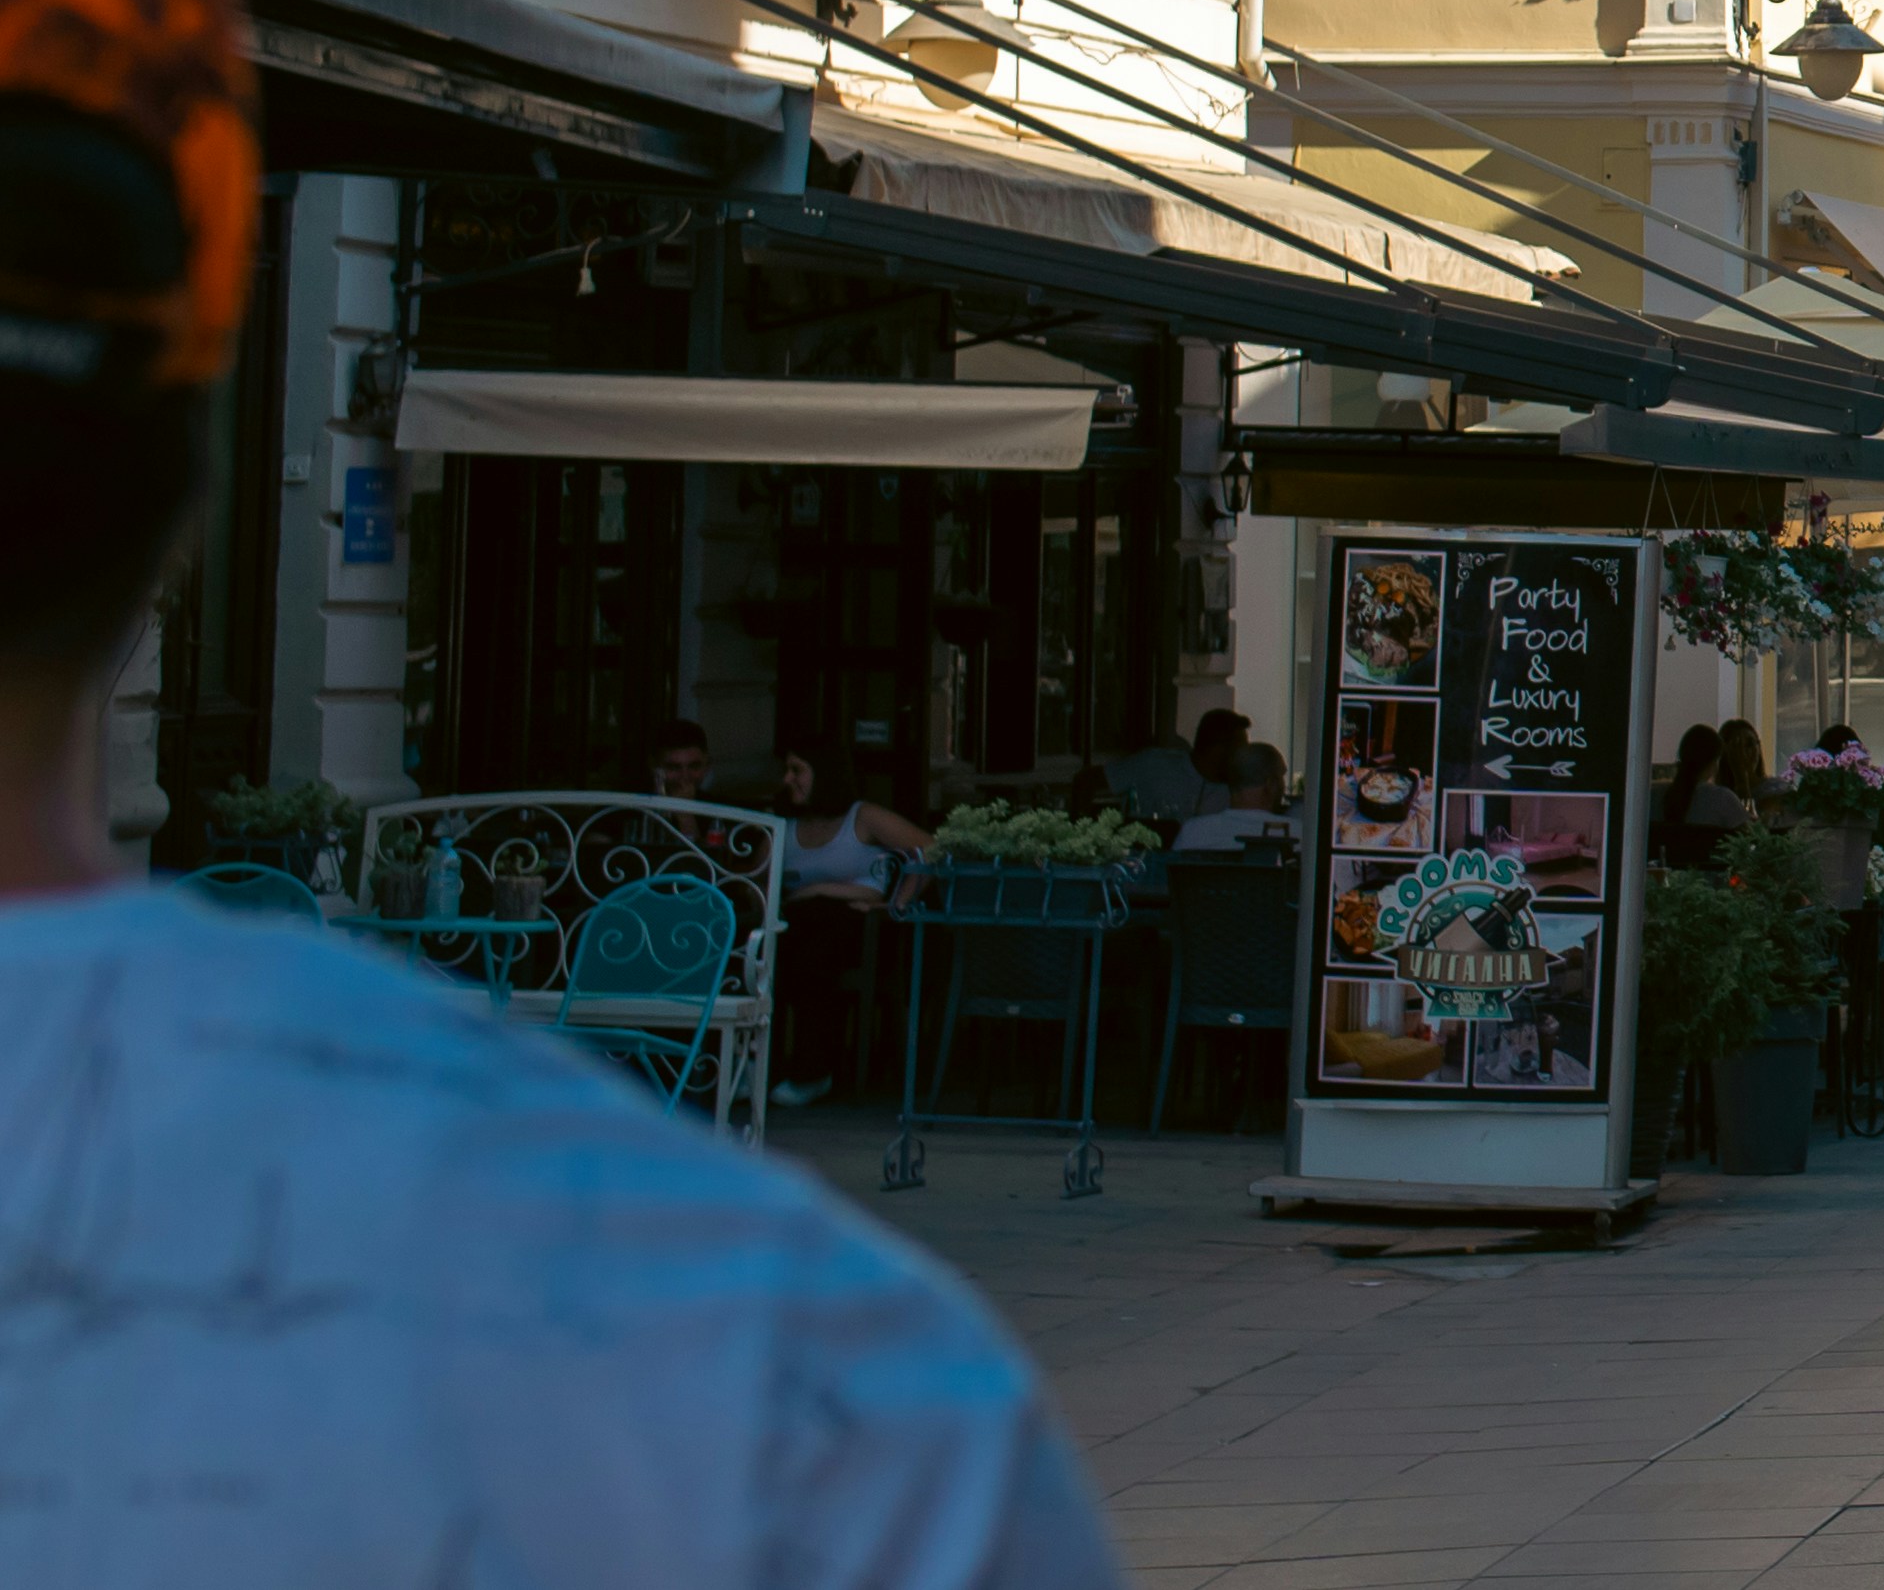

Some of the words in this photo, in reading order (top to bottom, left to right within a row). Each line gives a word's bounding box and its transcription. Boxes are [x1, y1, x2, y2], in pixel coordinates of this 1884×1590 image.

[1489, 576, 1580, 624] Party
[1502, 616, 1588, 655] Food
[1527, 654, 1553, 683] &
[1488, 678, 1580, 723] Luxury
[1481, 716, 1588, 748] Rooms
[1379, 853, 1519, 934] ROOMS
[1409, 949, 1533, 983] ЧИТАЛНА
